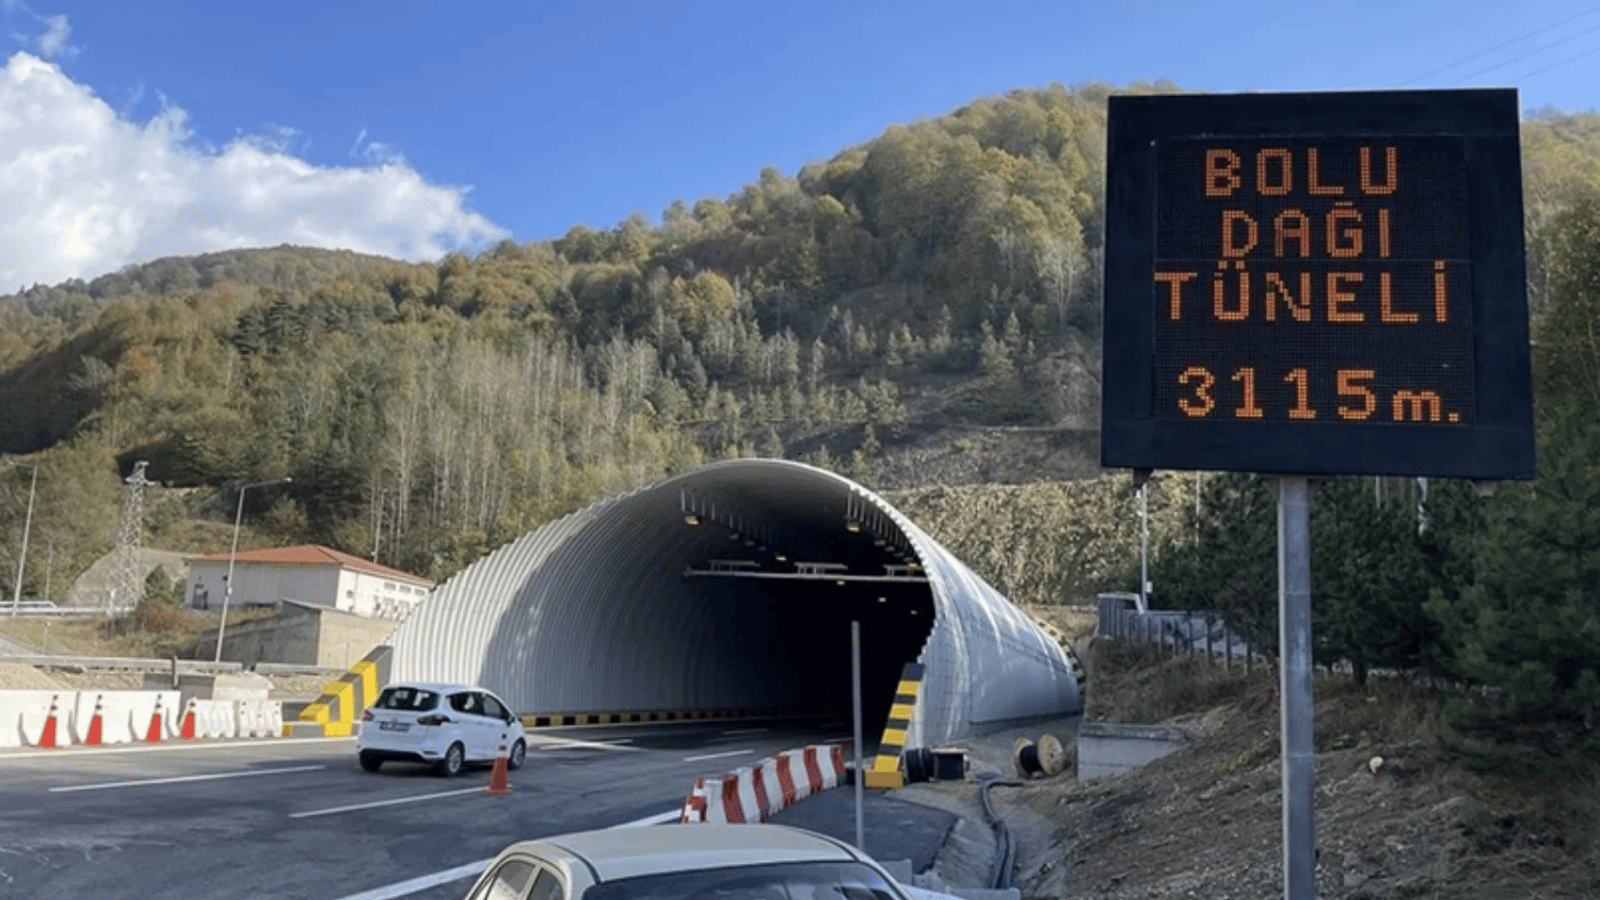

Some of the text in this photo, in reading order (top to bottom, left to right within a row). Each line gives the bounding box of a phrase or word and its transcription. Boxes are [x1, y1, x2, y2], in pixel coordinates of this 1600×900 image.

[1205, 146, 1397, 196] BOLU
[1222, 201, 1390, 258] DAĞI
[1154, 259, 1447, 322] TÜNELİ
